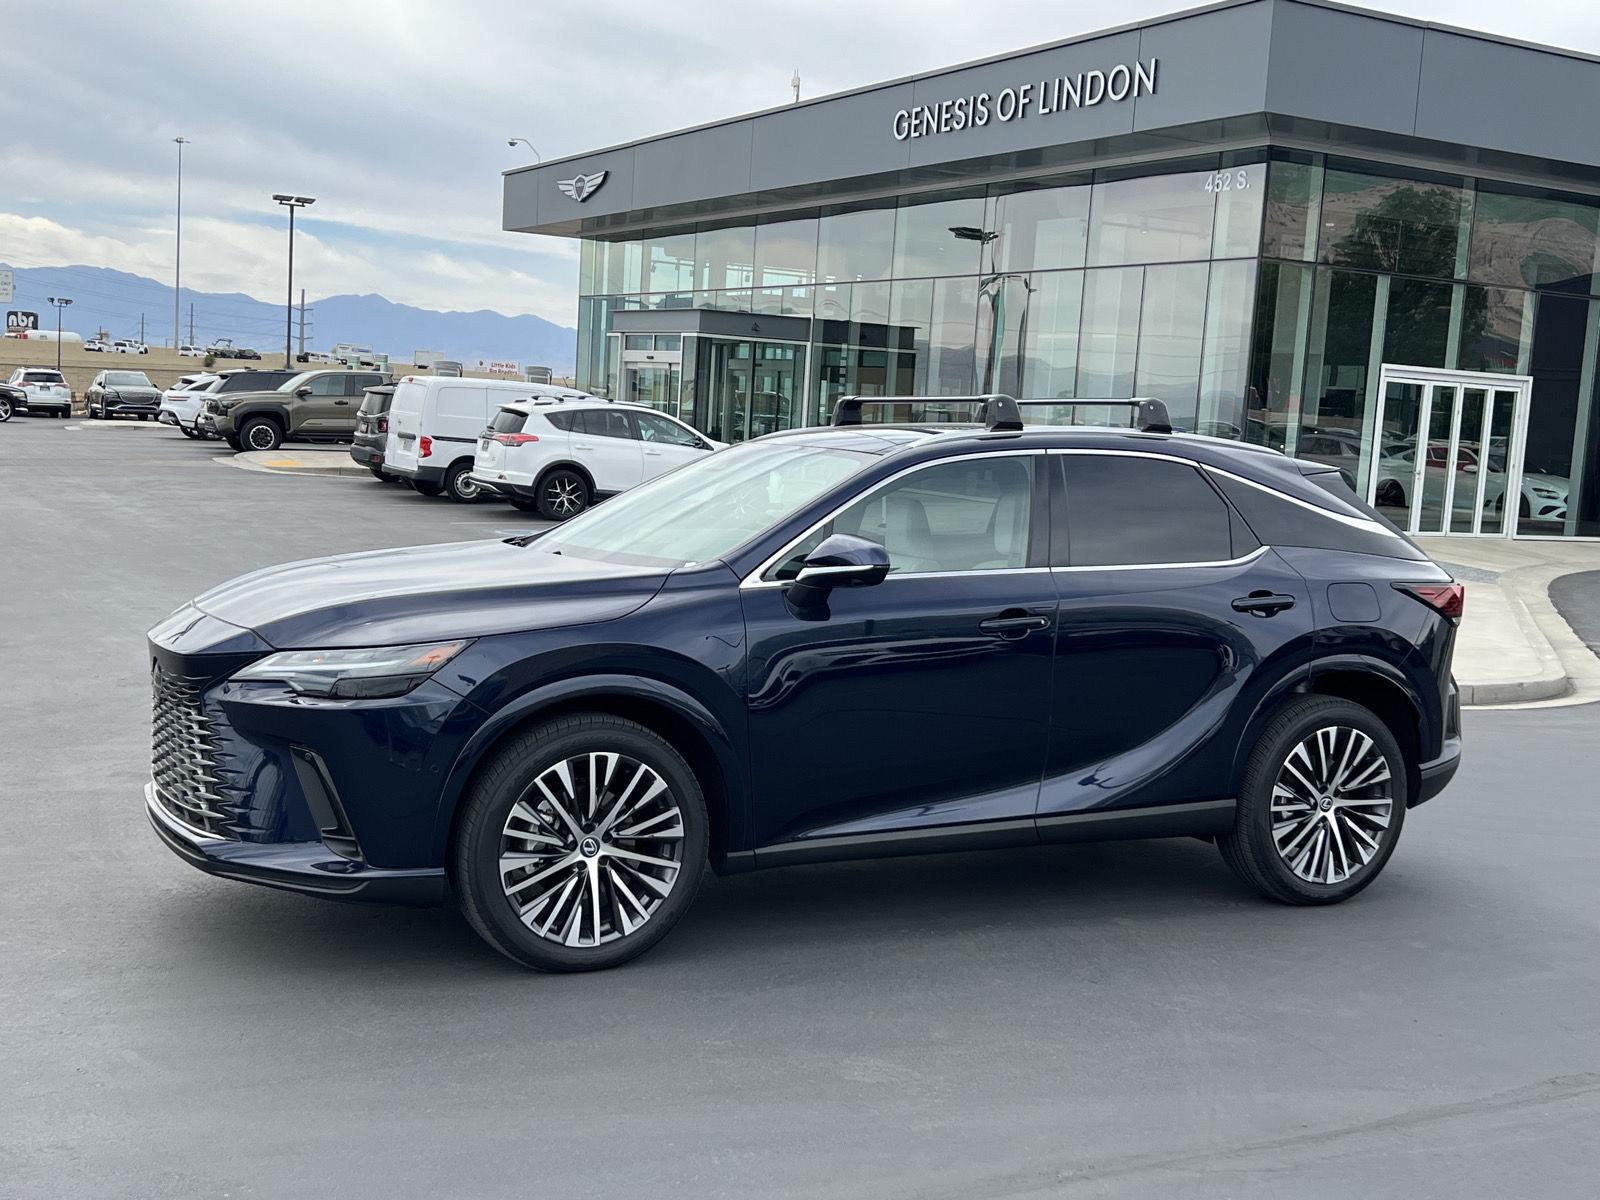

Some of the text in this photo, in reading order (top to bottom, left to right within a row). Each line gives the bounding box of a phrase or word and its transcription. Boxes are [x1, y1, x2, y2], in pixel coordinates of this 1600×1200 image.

[893, 57, 1159, 140] GENESIS OF LINDON
[1204, 170, 1250, 192] 452 S.
[8, 311, 34, 328] nbr
